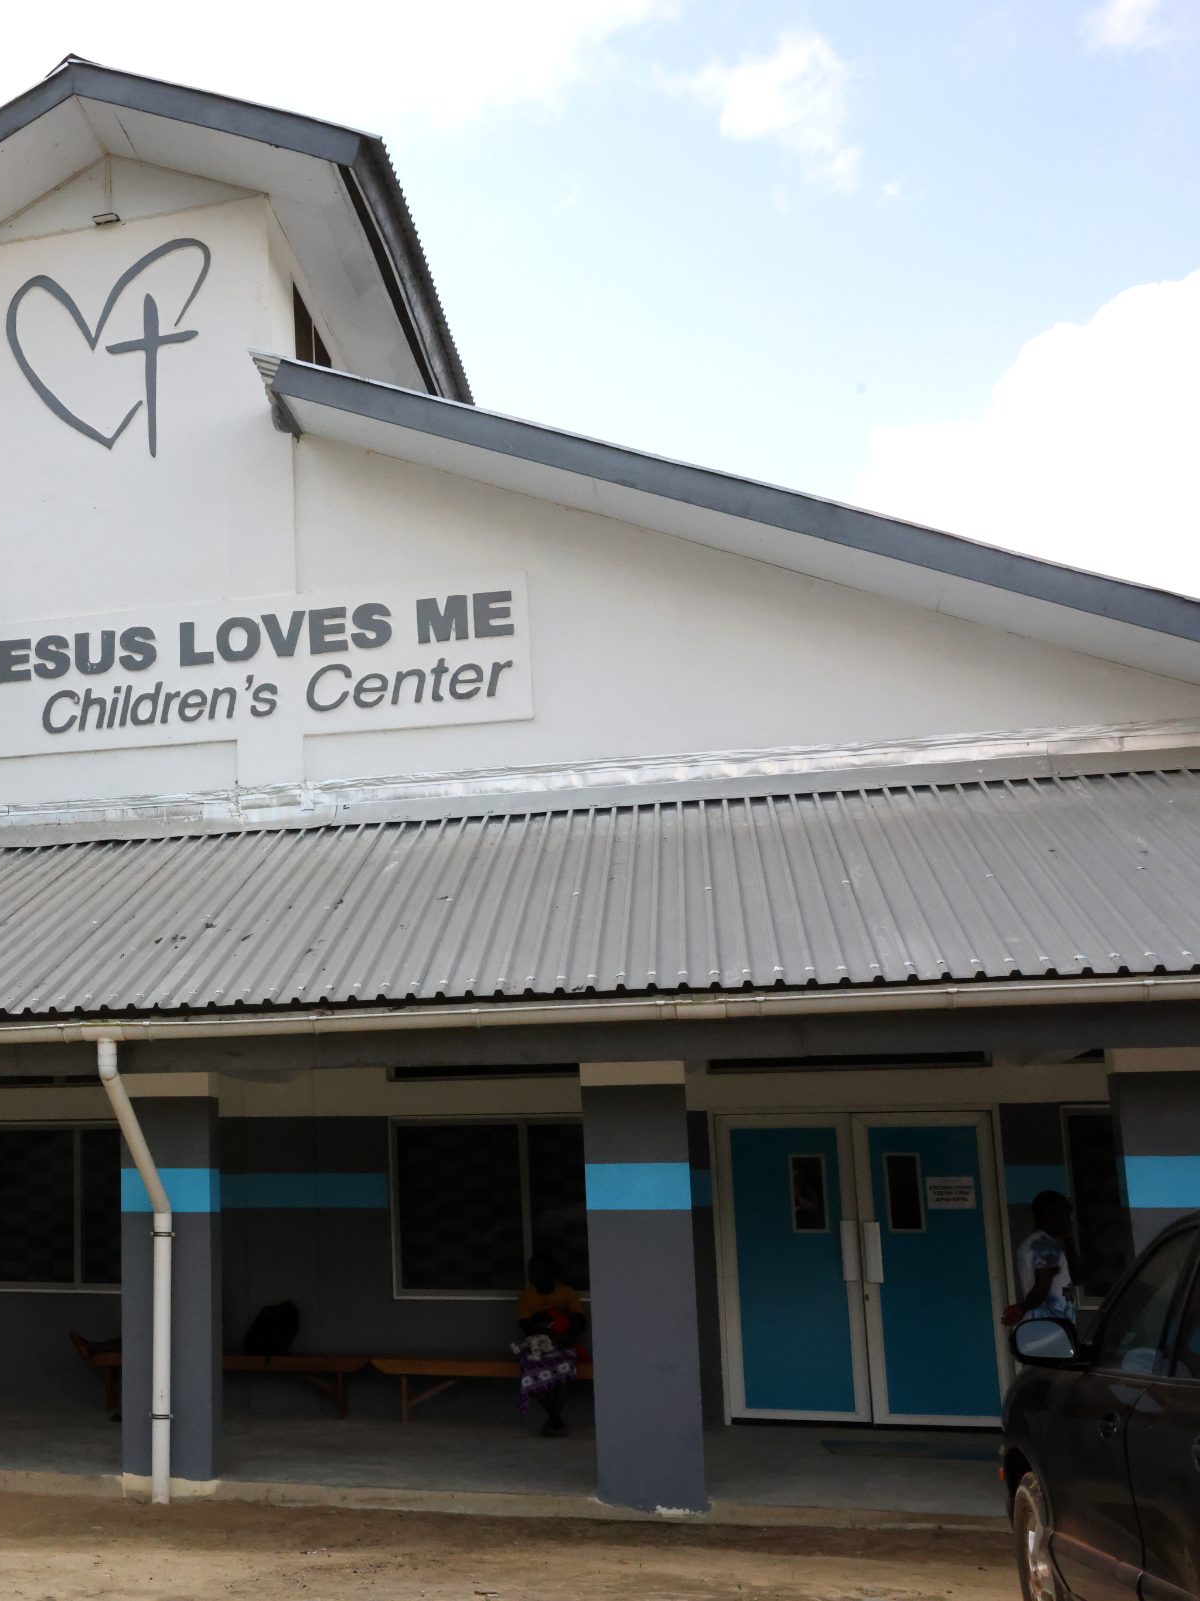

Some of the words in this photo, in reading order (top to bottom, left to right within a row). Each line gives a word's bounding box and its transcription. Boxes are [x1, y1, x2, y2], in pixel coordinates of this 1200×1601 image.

[180, 602, 393, 668] LOVES
[415, 590, 515, 645] ME
[41, 674, 278, 735] Children's
[306, 657, 514, 713] Center
